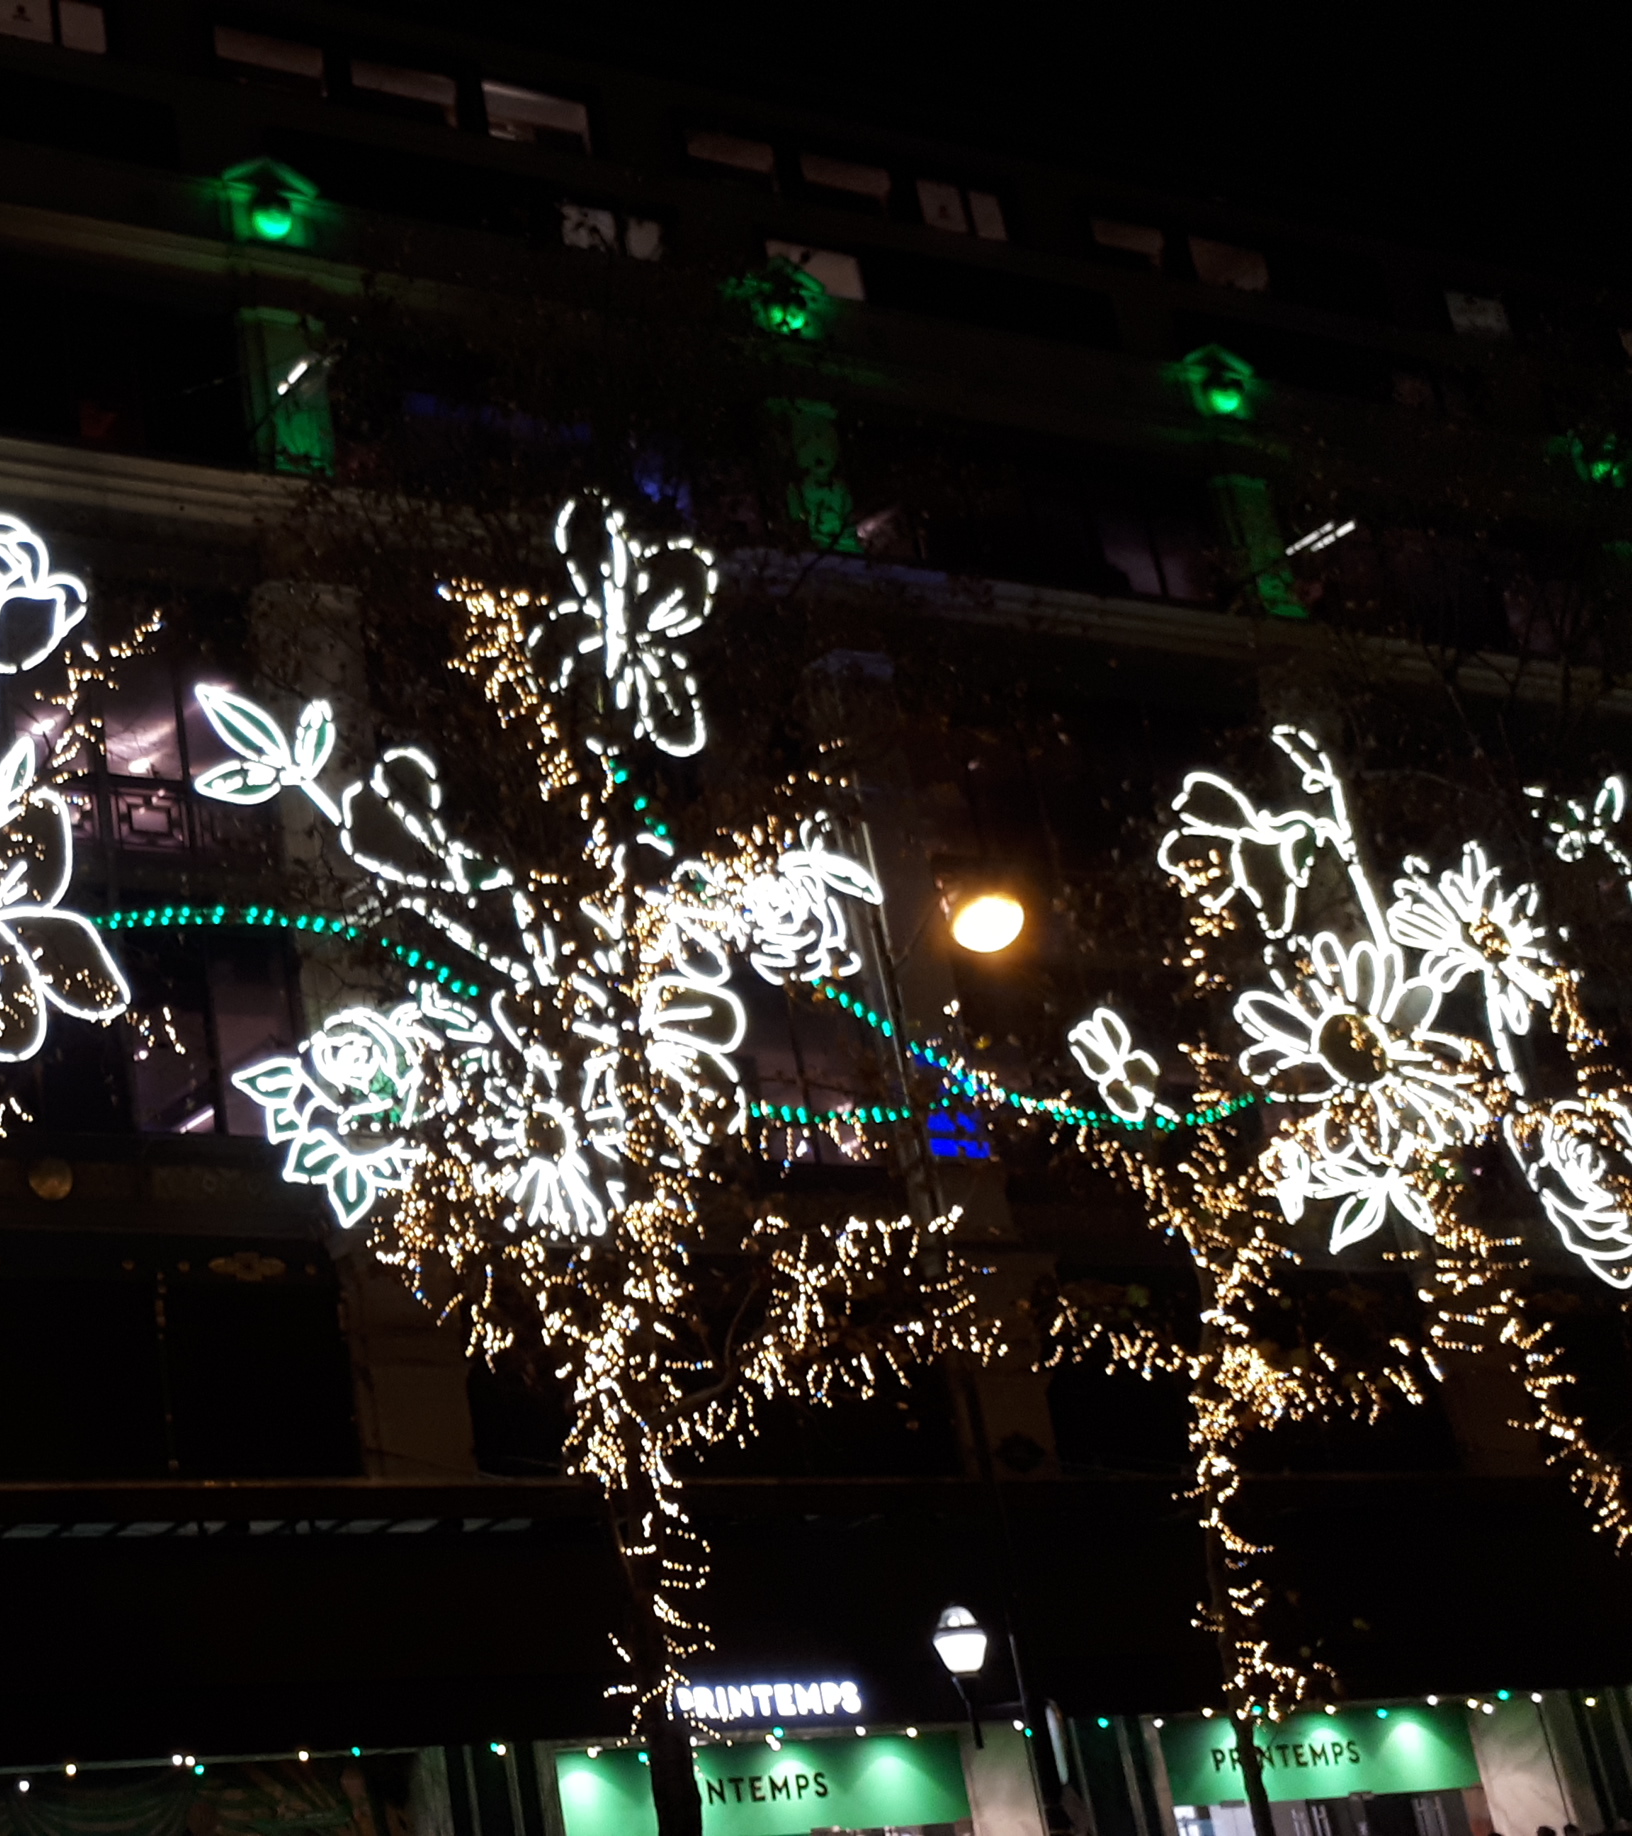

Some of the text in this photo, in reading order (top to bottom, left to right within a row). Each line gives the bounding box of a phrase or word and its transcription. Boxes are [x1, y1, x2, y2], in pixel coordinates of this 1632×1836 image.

[675, 1682, 861, 1718] PRINTEMPS
[1212, 1740, 1360, 1772] PRNTEMPS
[706, 1772, 829, 1804] NTEMPS
